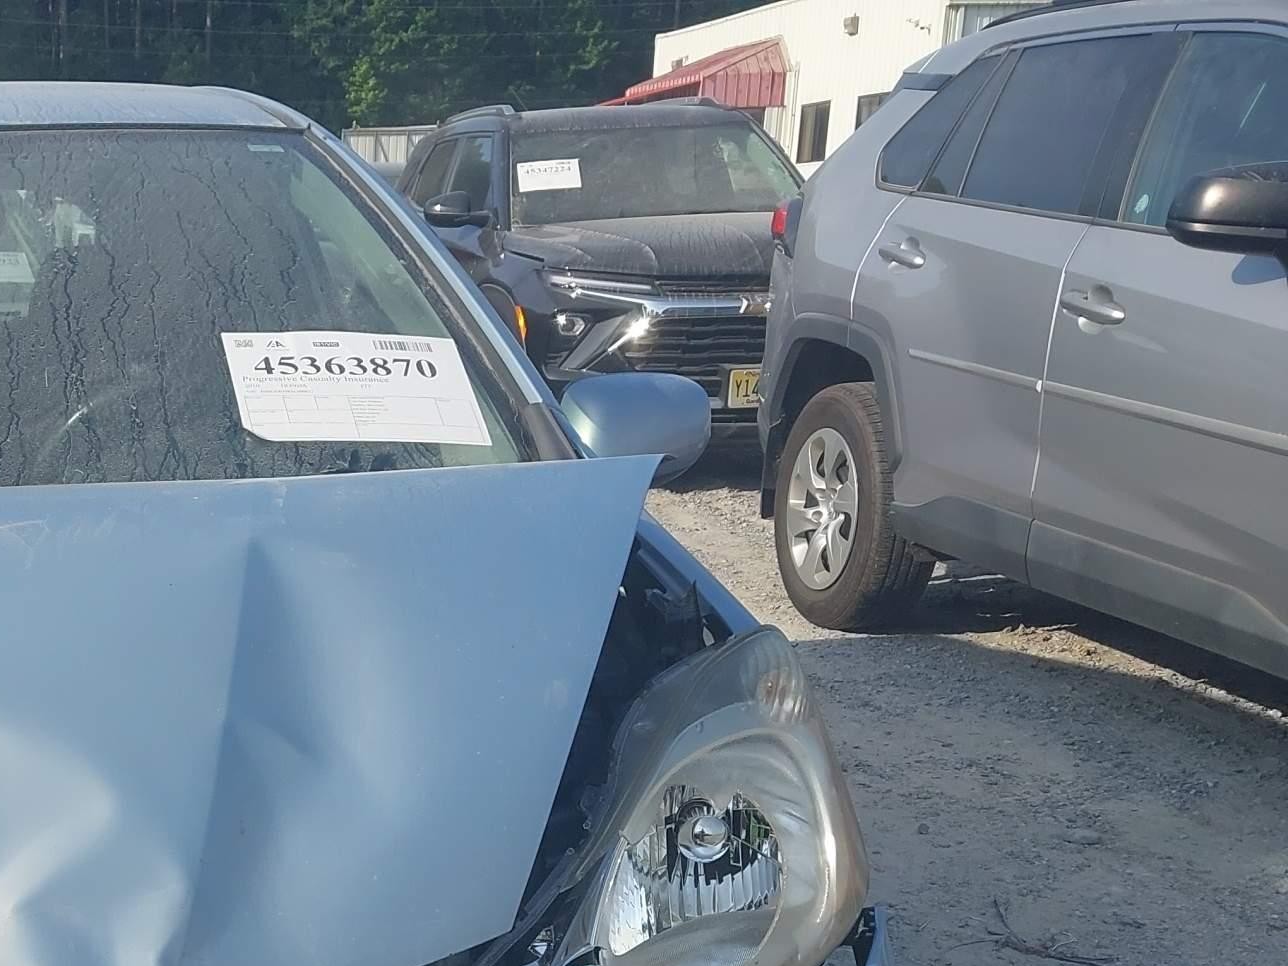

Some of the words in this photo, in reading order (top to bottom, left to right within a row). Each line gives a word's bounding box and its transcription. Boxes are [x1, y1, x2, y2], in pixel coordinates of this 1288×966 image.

[254, 356, 438, 379] 45363870
[242, 375, 298, 383] Progressive
[299, 375, 341, 383] Casualty
[344, 375, 391, 383] Insurance
